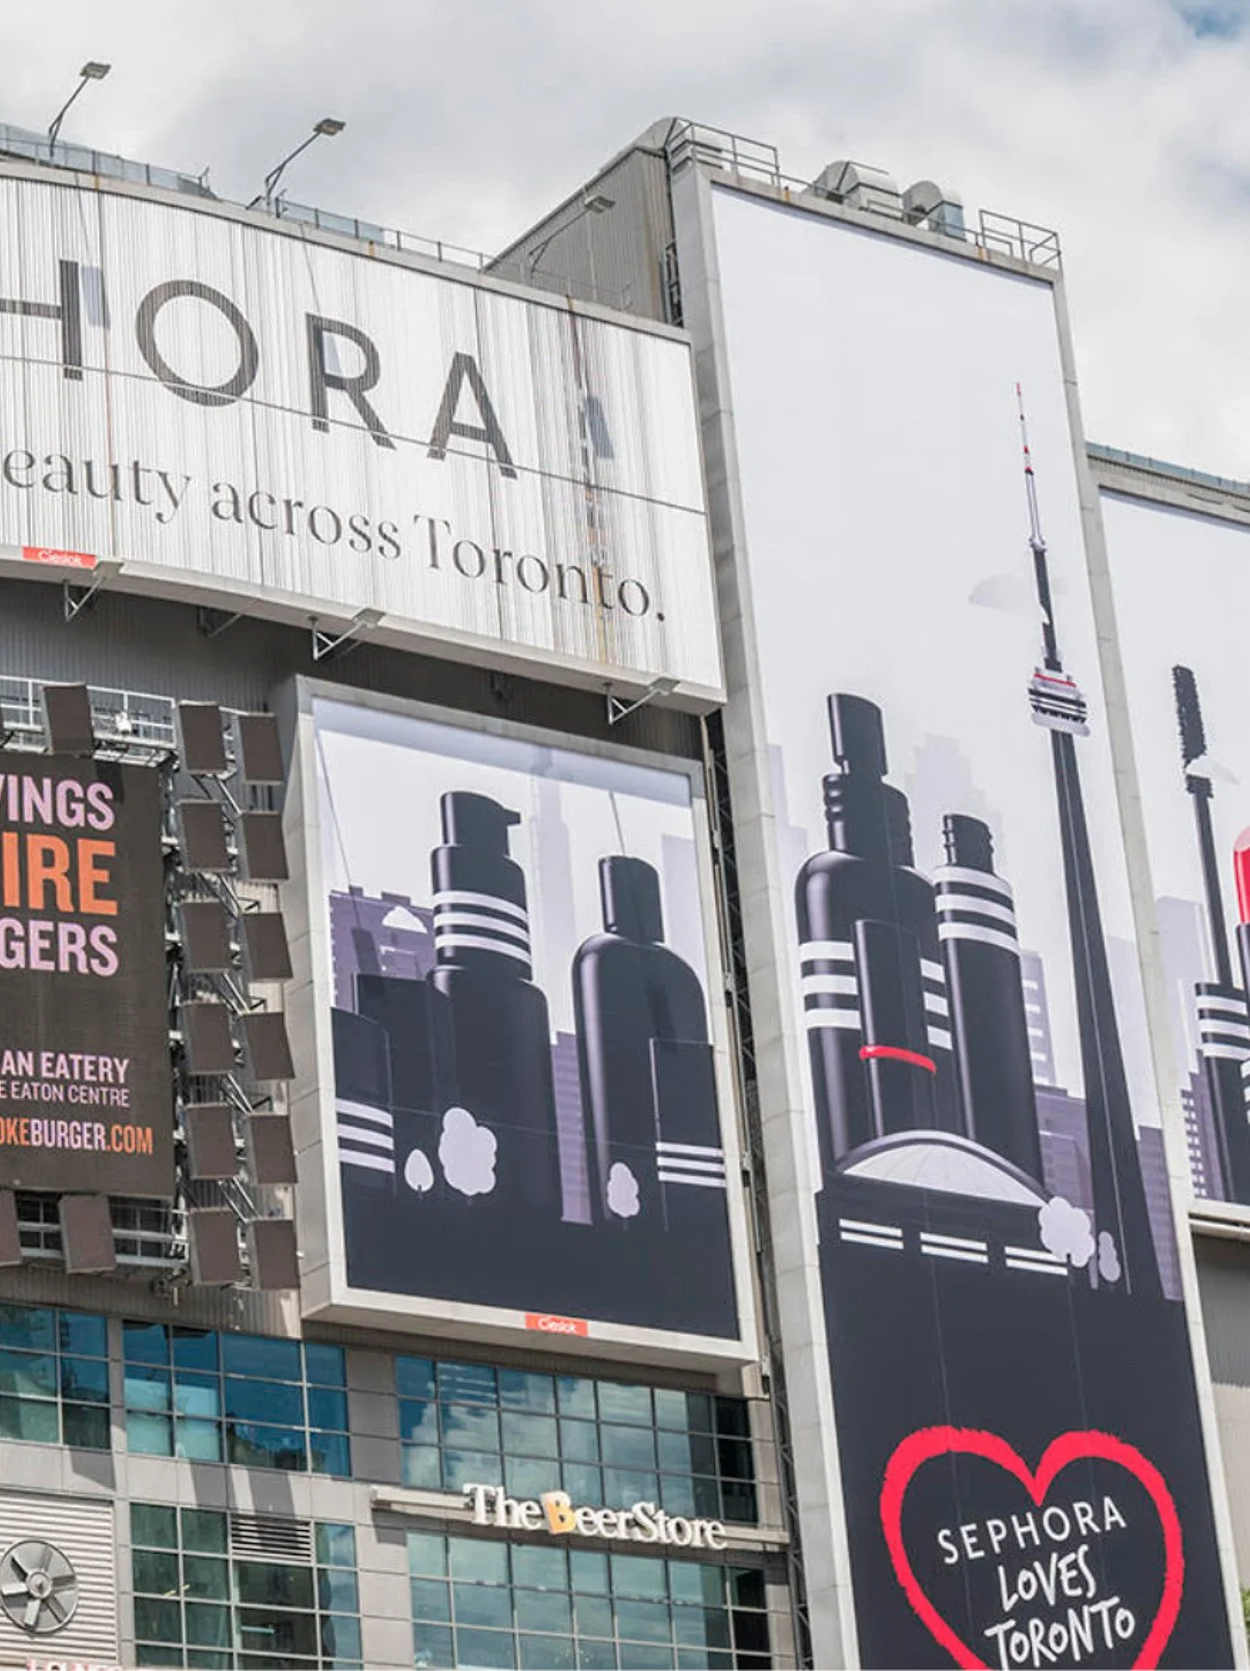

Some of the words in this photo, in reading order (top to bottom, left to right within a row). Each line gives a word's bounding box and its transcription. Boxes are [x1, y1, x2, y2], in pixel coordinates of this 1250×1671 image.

[212, 481, 401, 560] across
[414, 515, 666, 622] Toronto.
[11, 1081, 64, 1101] EATON
[68, 1085, 130, 1108] CENTRE
[41, 1052, 130, 1084] EATERY
[938, 1497, 1127, 1564] SEPHORA
[997, 1545, 1097, 1613] LOVES
[984, 1597, 1136, 1671] TORONTO
